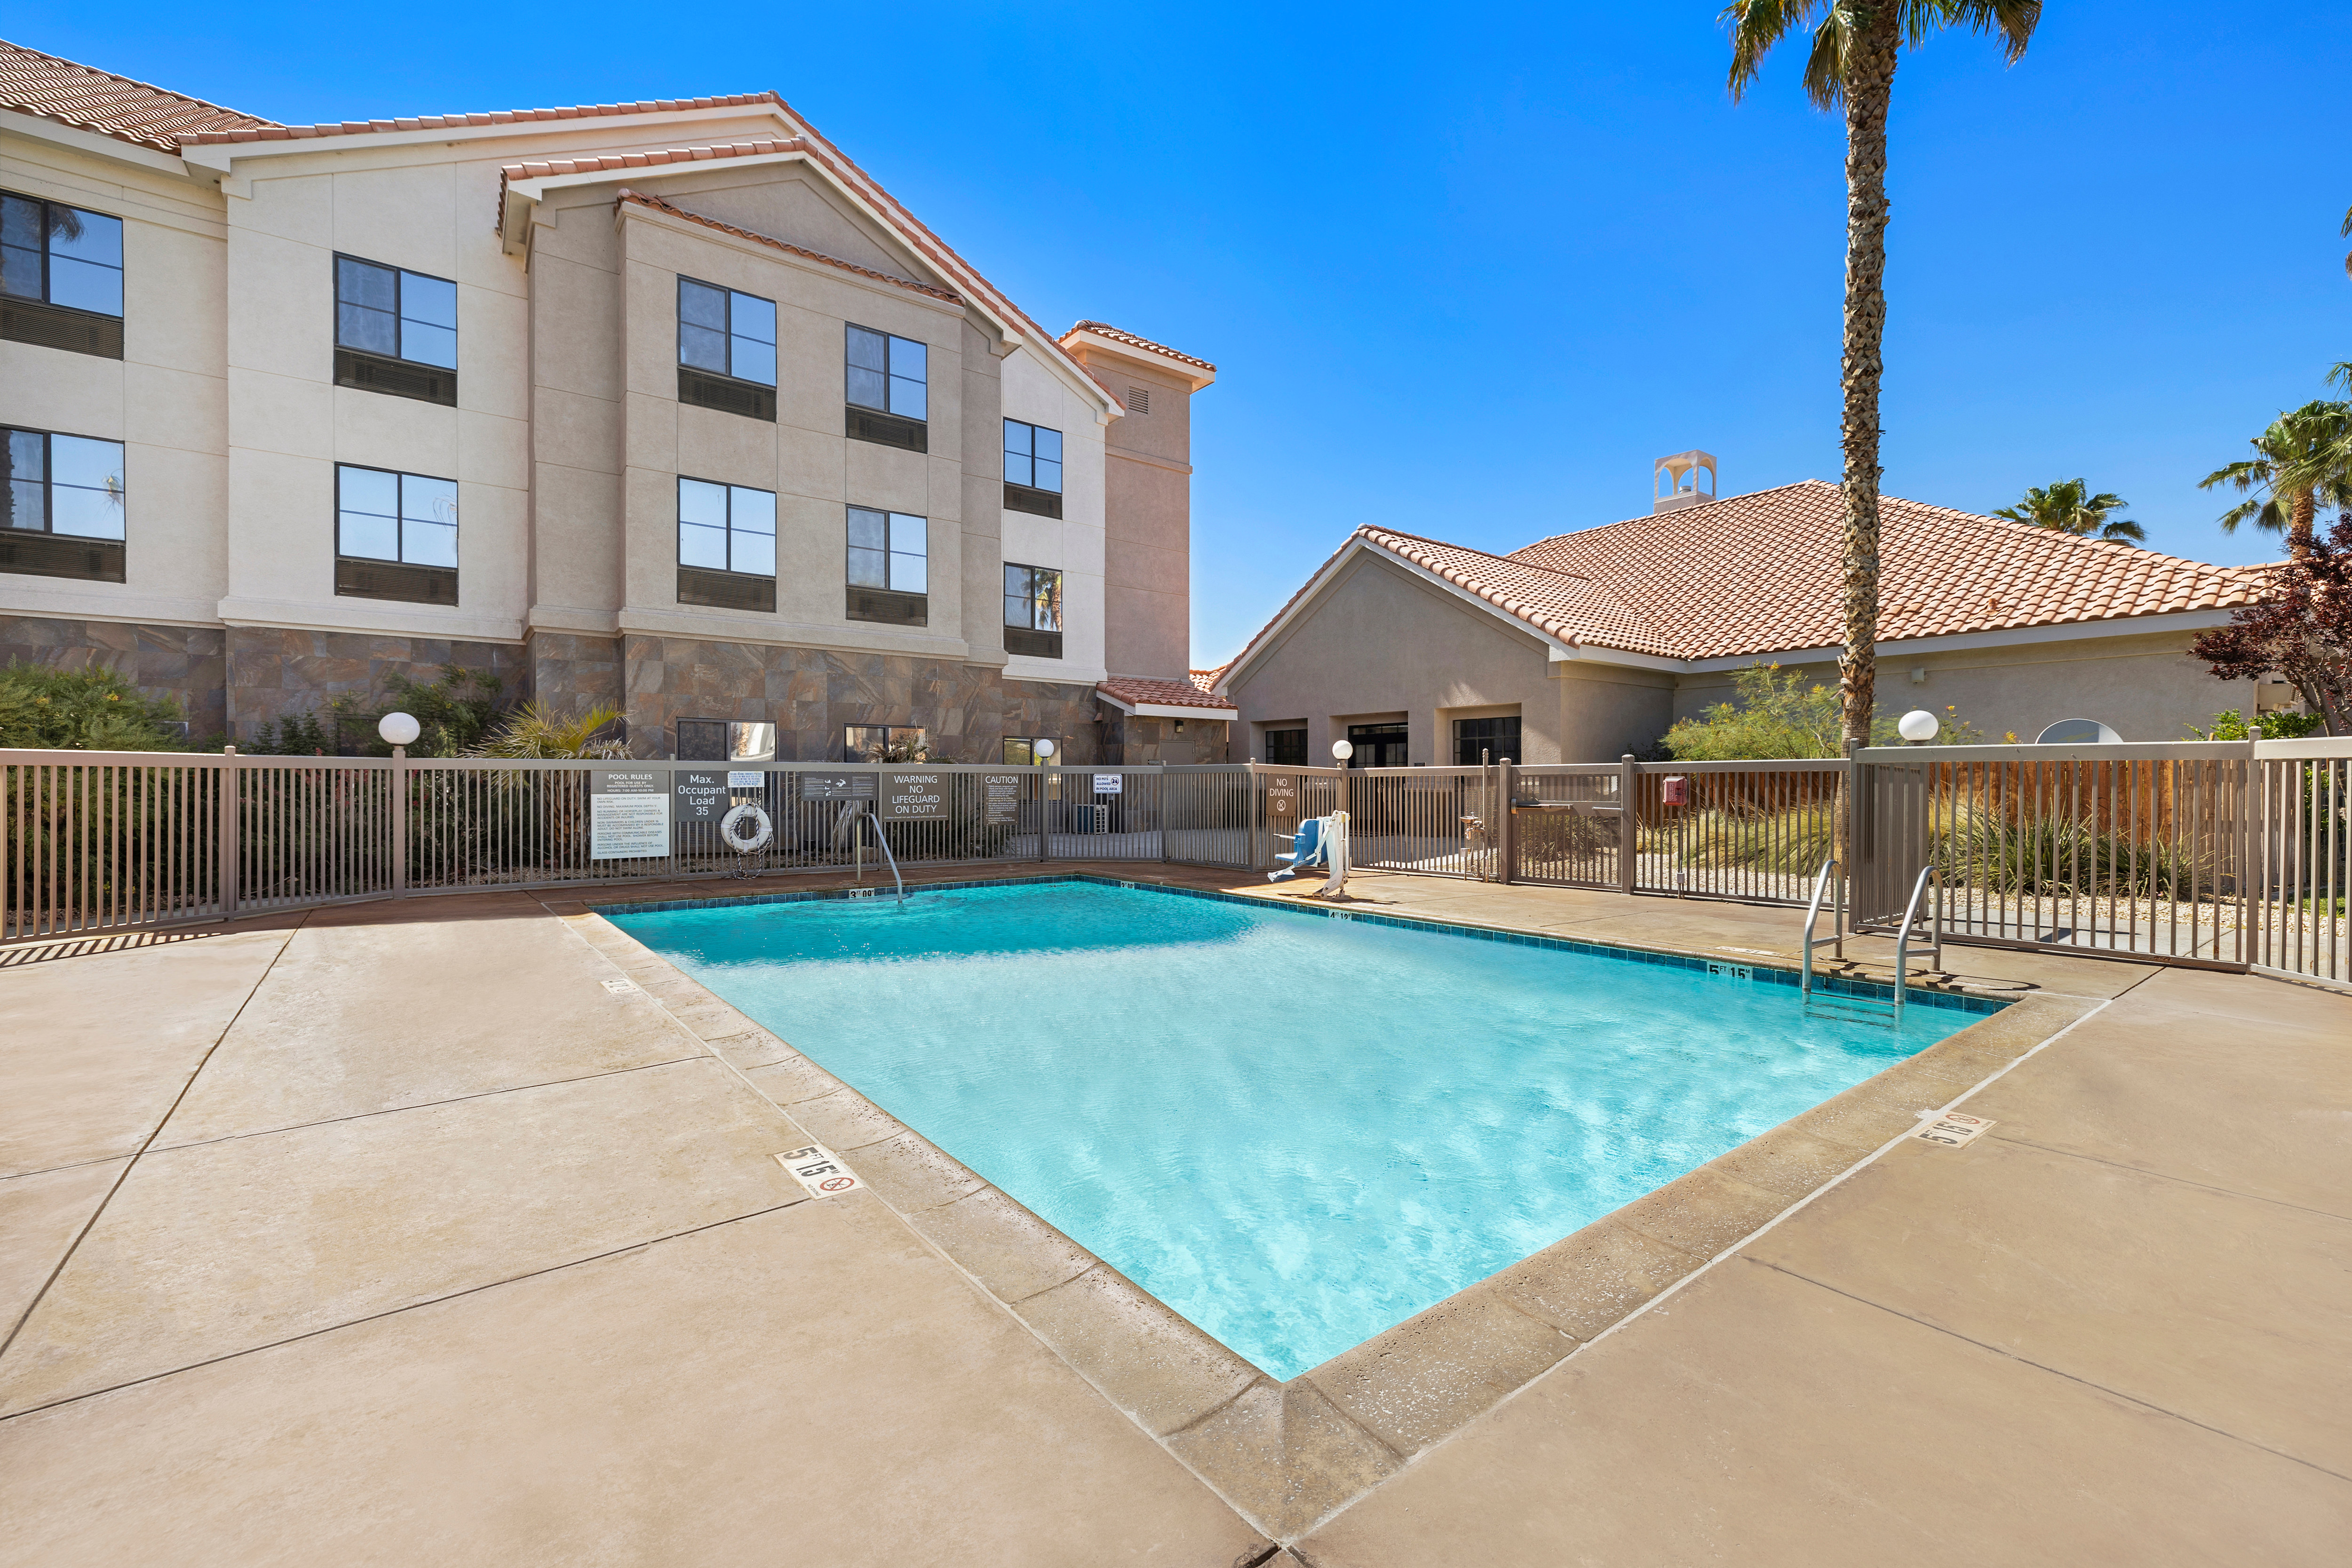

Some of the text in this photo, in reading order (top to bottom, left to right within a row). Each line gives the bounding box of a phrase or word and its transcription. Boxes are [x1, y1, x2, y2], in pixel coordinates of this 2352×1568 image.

[690, 775, 714, 783] Max.
[678, 785, 726, 796] Occupant
[1270, 788, 1293, 797] DIVING
[690, 796, 714, 805] Load
[696, 807, 708, 815] 35
